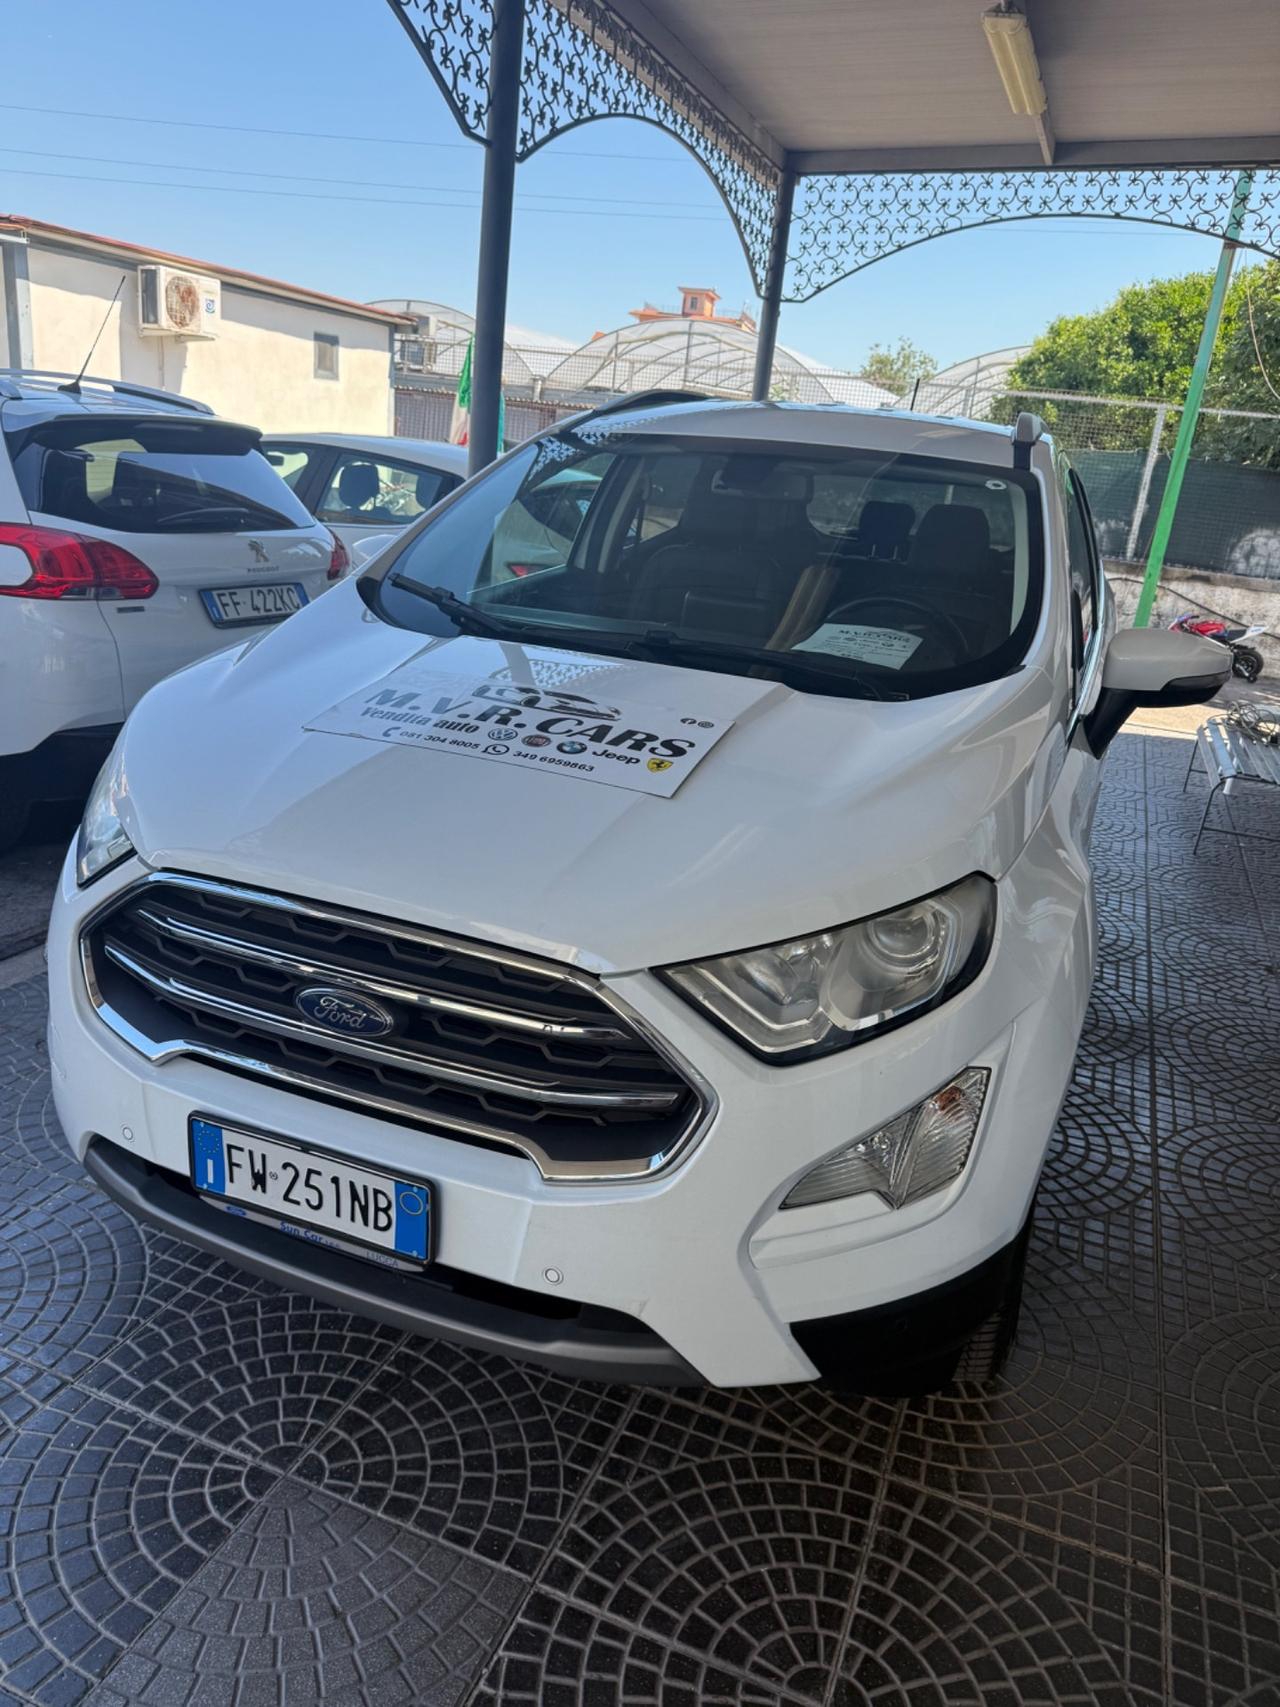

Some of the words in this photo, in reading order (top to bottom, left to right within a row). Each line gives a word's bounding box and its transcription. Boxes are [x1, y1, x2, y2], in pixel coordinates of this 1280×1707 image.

[360, 707, 433, 725] Vendita
[432, 720, 480, 733] auto
[513, 750, 538, 760] 349
[592, 749, 641, 764] Jeep
[314, 996, 367, 1028] Ford
[226, 1143, 267, 1194] FW
[281, 1162, 393, 1232] 251NB
